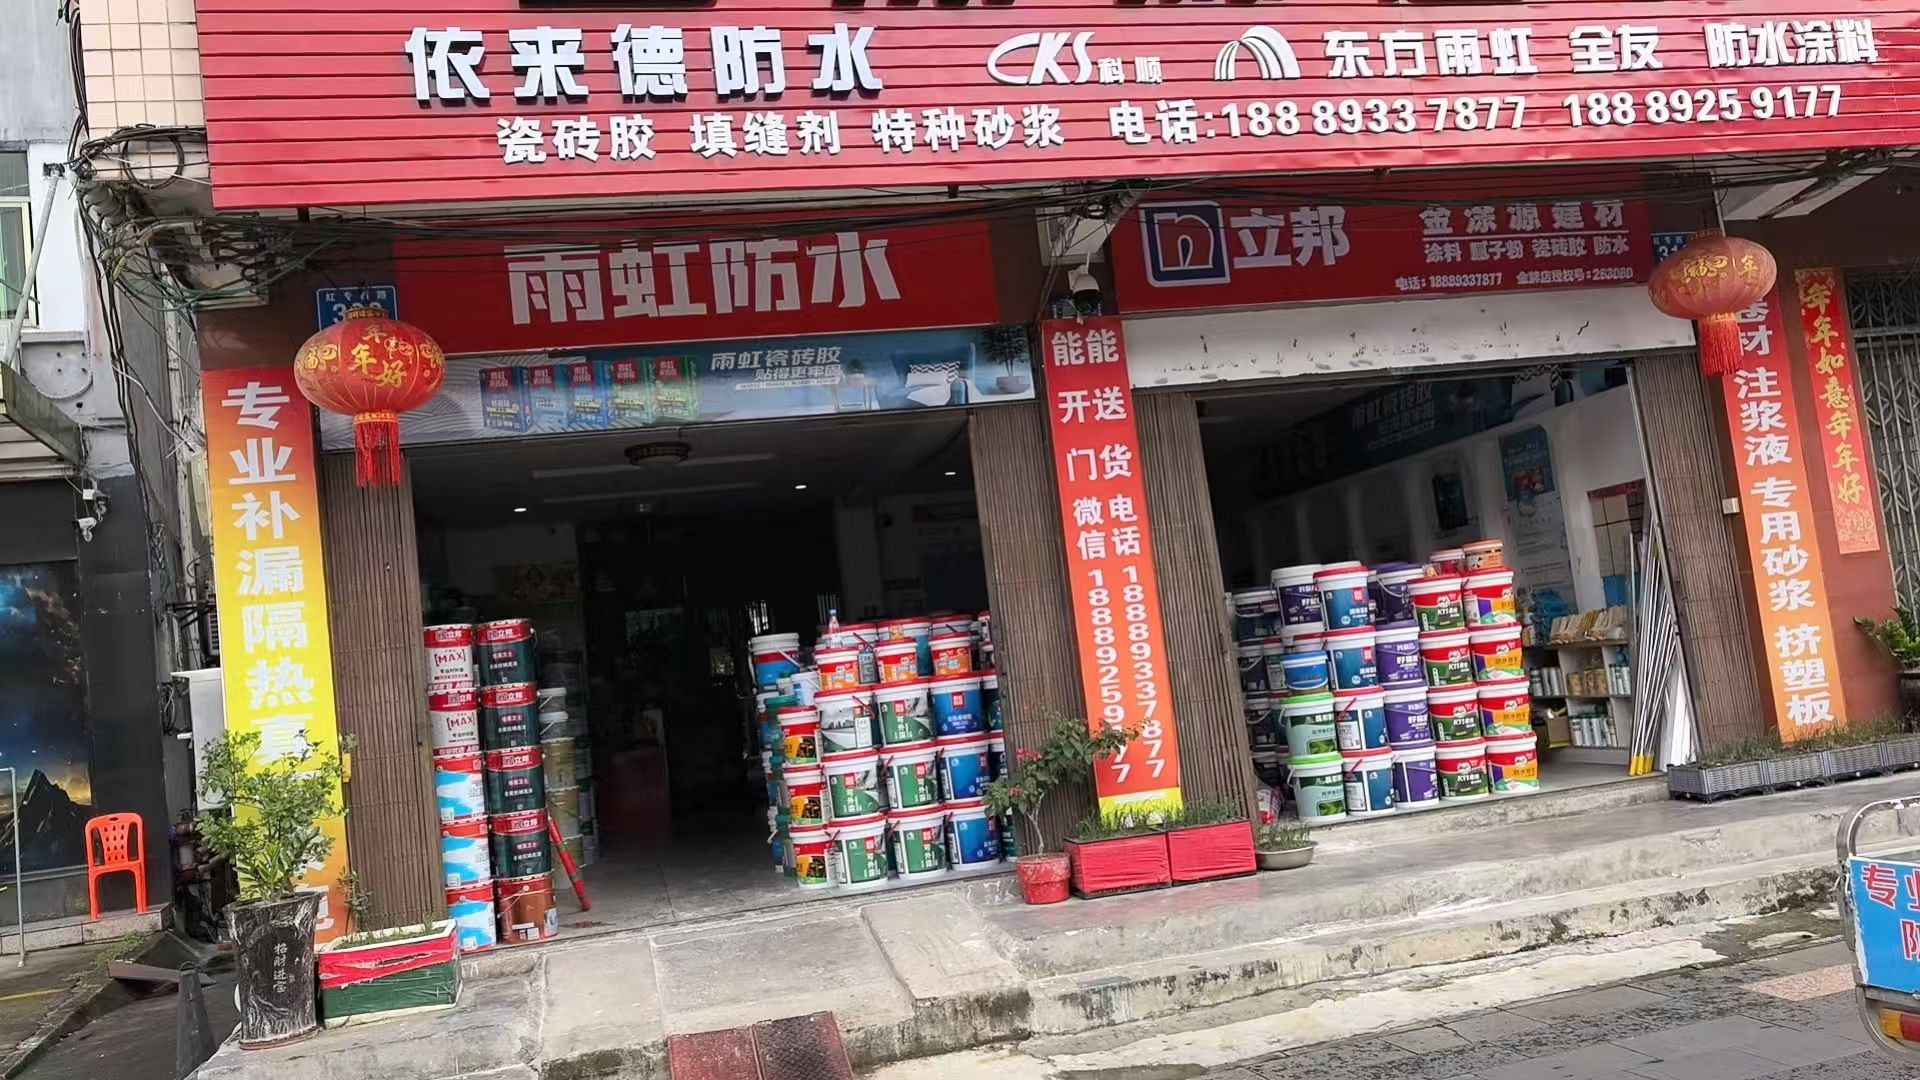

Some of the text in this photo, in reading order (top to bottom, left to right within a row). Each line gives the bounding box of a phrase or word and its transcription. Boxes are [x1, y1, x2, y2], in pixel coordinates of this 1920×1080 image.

[405, 23, 884, 103] 依来德防水
[986, 31, 1096, 85] CKS
[1097, 56, 1163, 84] 科顺
[1323, 27, 1540, 80] 东方雨虹
[1703, 18, 1879, 69] 防水涂料
[496, 114, 656, 164] 瓷砖胶
[689, 110, 841, 159] 填缝剂
[871, 104, 1066, 153] 特种砂浆
[1312, 98, 1417, 136] 8933
[1425, 95, 1527, 132] 7877
[1562, 91, 1636, 128] 188
[1645, 87, 1742, 125] 8925
[1750, 84, 1843, 120] 9177
[1229, 205, 1350, 269] 立邦
[1424, 241, 1463, 264] 涂料
[1532, 235, 1587, 259] 瓷砖胶
[1593, 234, 1630, 256] 防水
[504, 231, 902, 325] 雨虹防水
[710, 346, 843, 371] 雨虹瓷砖胶
[1803, 283, 1866, 505] 年年如意年年好
[1733, 366, 1793, 467] 注浆液
[1073, 496, 1106, 561] 微信
[1108, 493, 1142, 557] 电话
[1750, 477, 1816, 613] 专用砂浆
[1088, 568, 1132, 783] 188892597
[1122, 565, 1166, 778] 18889337877
[1775, 624, 1835, 726] 挤塑板
